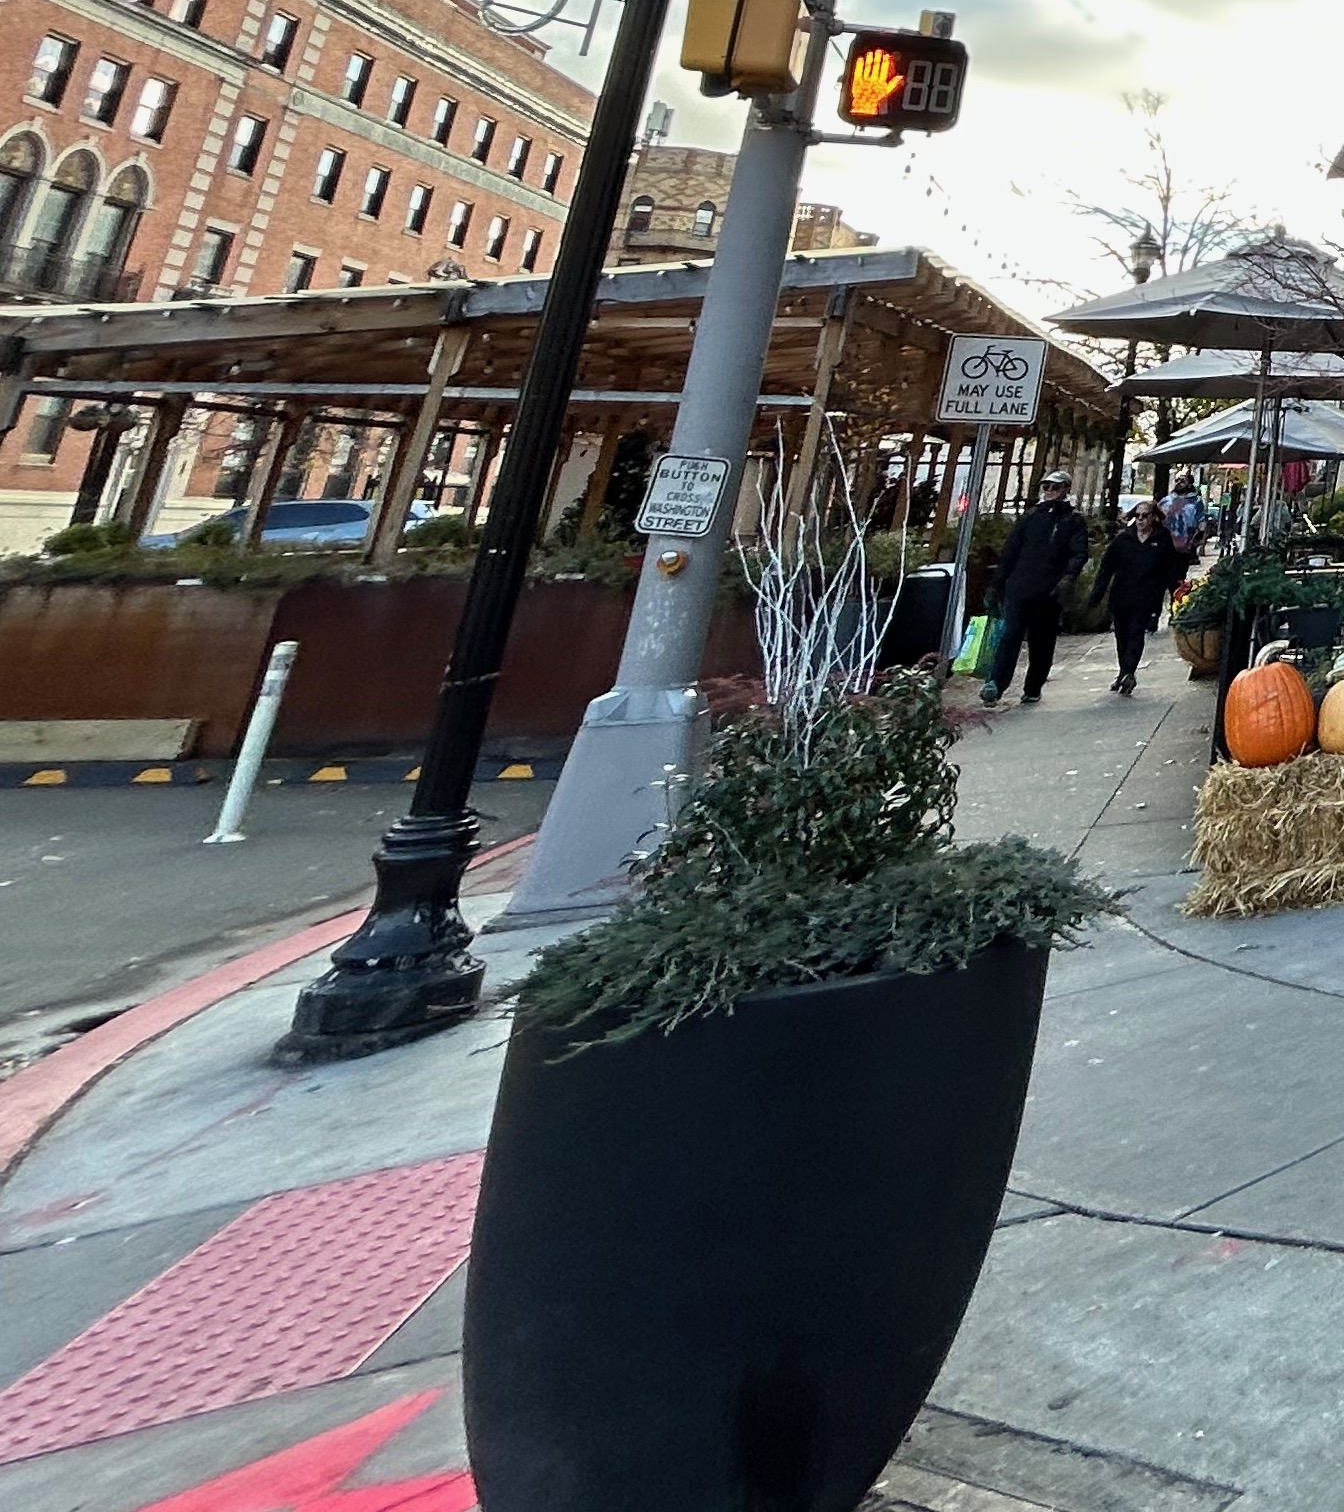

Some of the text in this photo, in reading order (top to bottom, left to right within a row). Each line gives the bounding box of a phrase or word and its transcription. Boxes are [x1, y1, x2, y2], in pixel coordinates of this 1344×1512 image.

[957, 384, 1023, 399] MAY USE
[945, 400, 1029, 416] FULL LANE
[680, 460, 709, 470] PUSH
[659, 469, 721, 483] BUTTON
[681, 481, 694, 491] TO
[667, 491, 700, 503] CROSS
[648, 503, 711, 518] WASHINGTON
[643, 516, 705, 531] STREET
